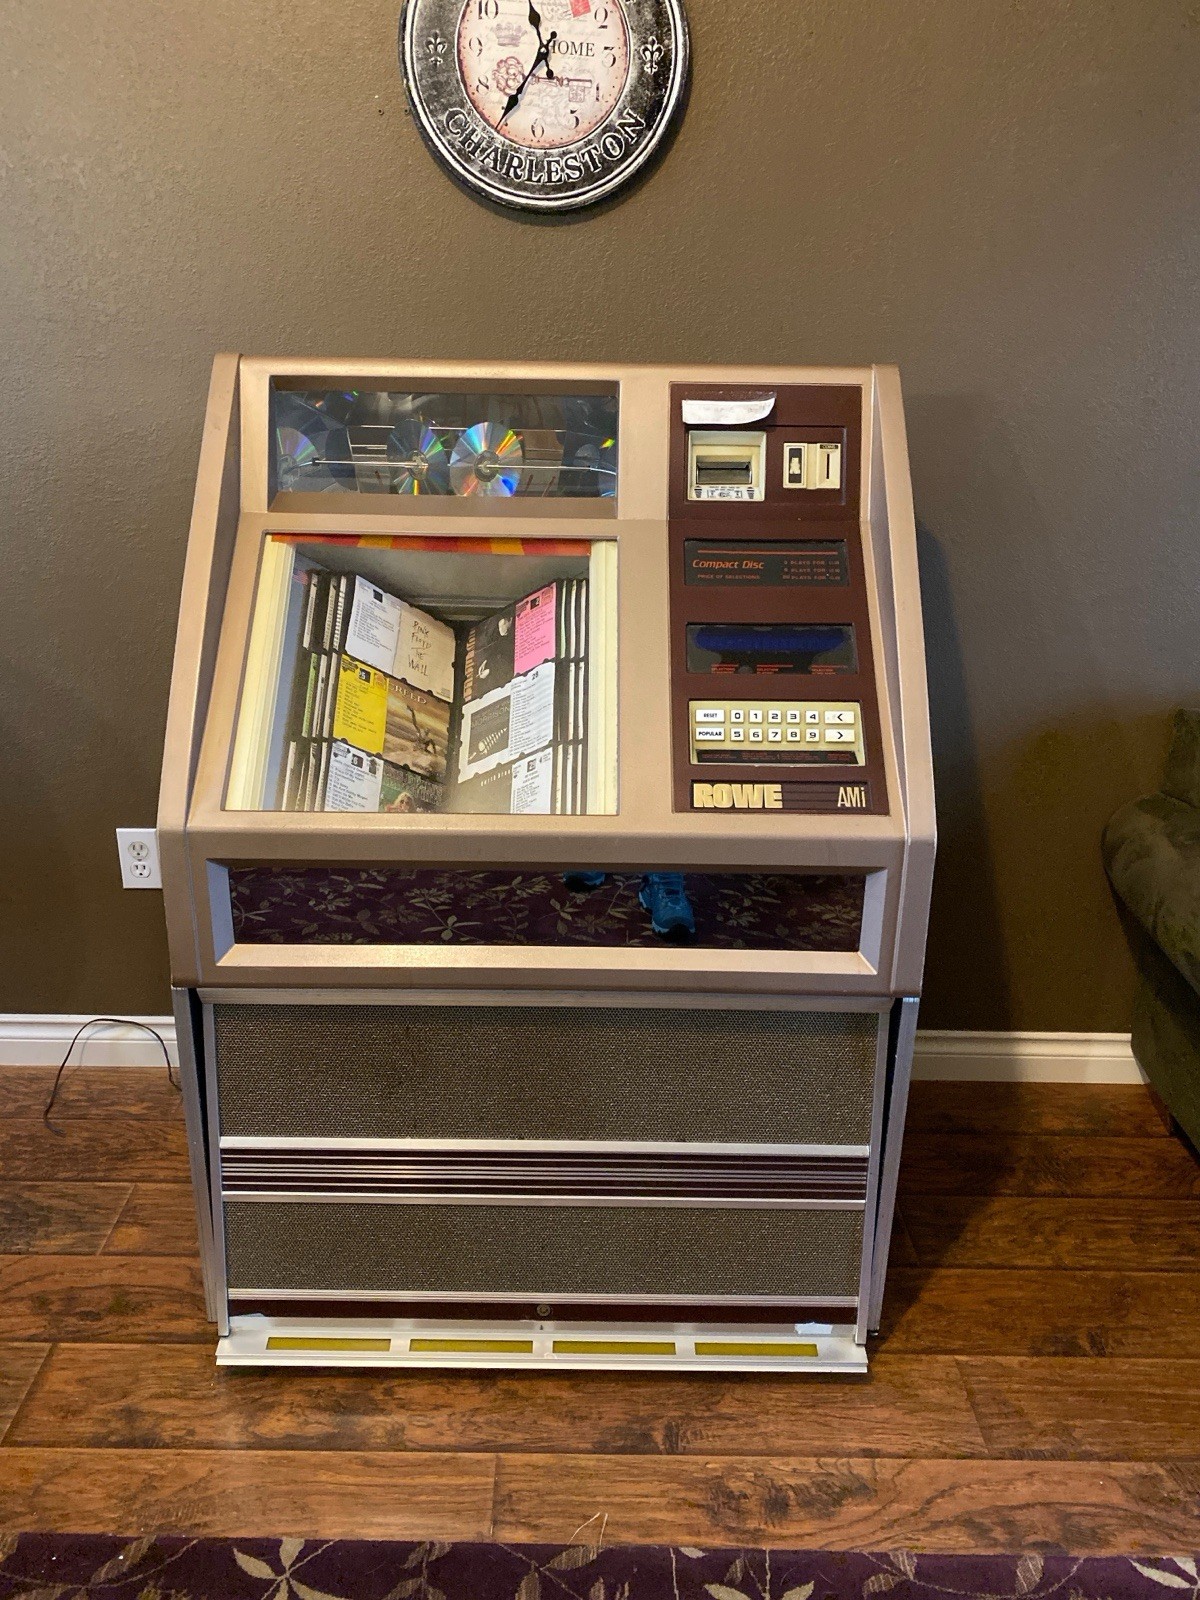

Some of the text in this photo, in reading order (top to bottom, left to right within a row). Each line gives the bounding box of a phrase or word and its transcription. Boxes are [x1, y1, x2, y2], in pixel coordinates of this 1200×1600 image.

[594, 8, 609, 30] 2
[468, 37, 484, 58] 9
[601, 46, 617, 68] 3
[443, 107, 647, 184] CHARLESTON
[692, 559, 765, 570] Compact Disc
[734, 712, 741, 720] 0
[809, 731, 817, 739] 9
[693, 783, 867, 809] ROWE AMi
